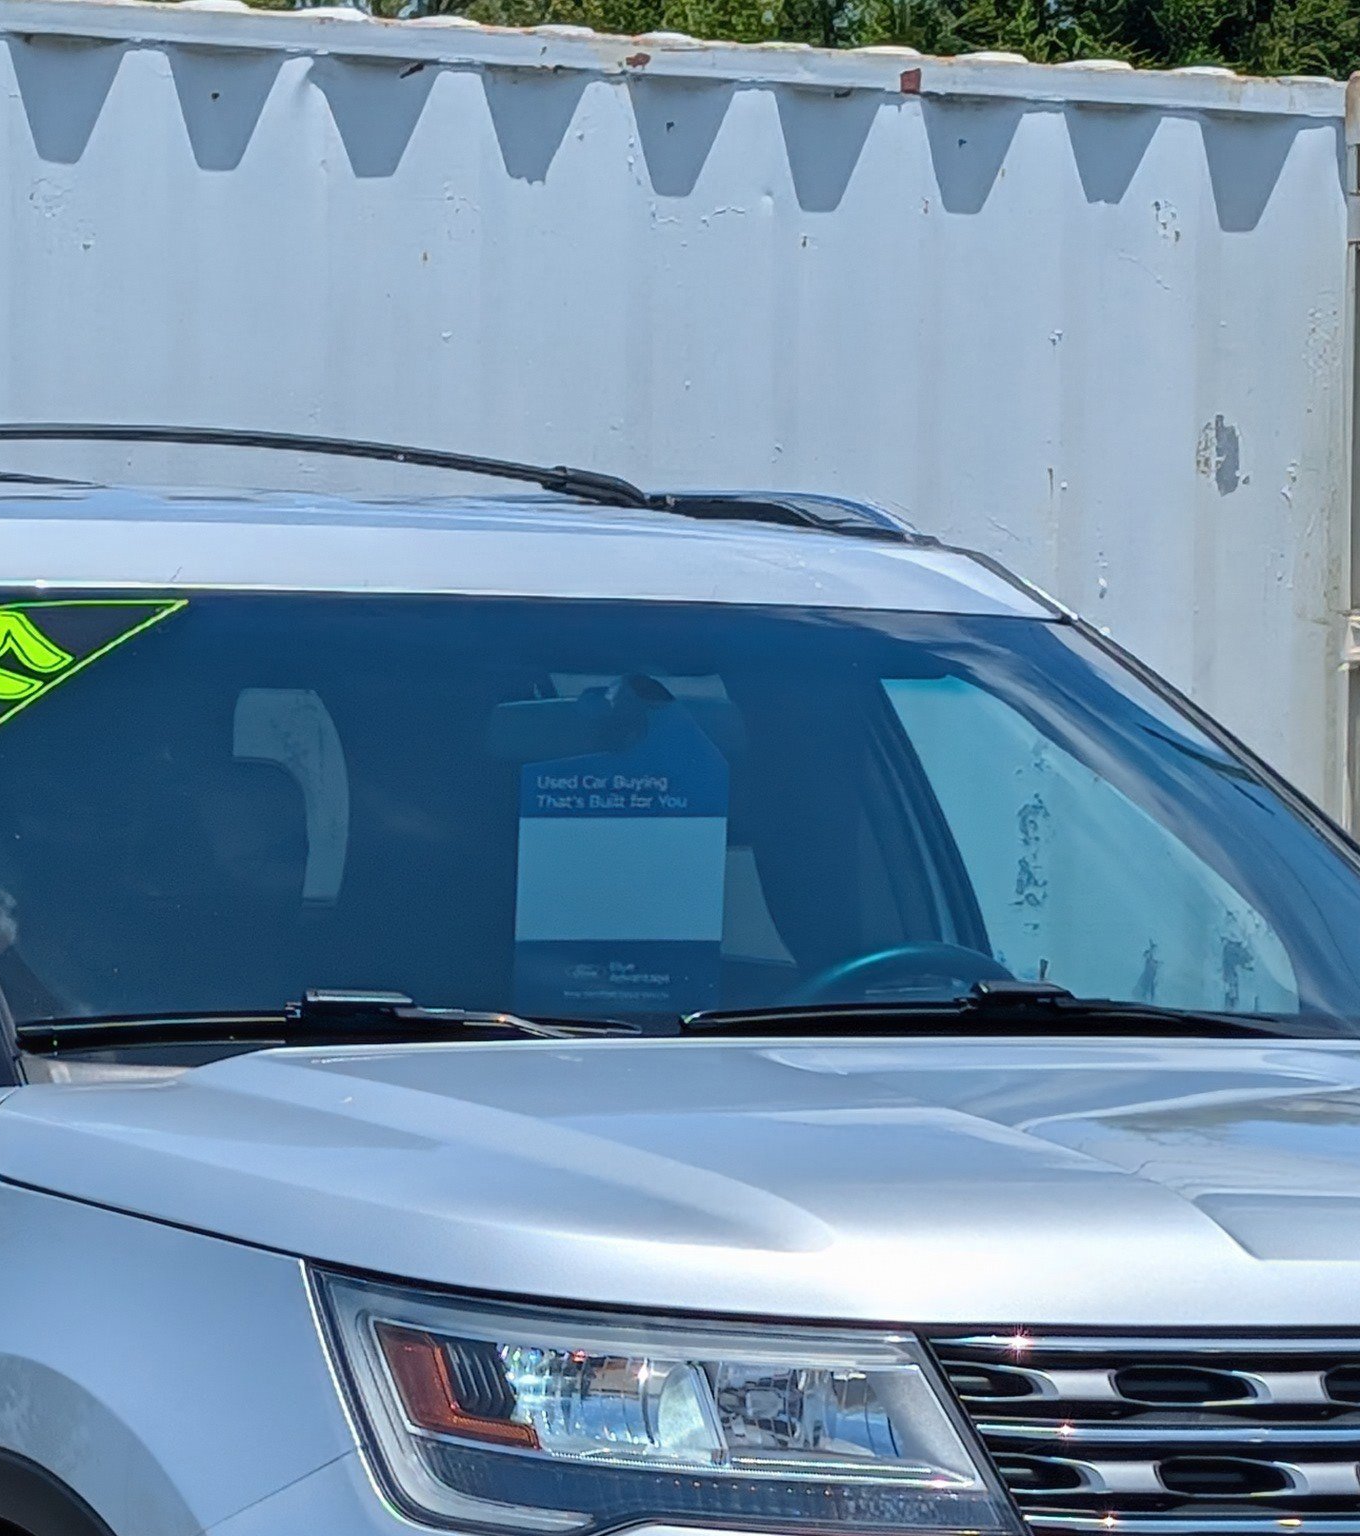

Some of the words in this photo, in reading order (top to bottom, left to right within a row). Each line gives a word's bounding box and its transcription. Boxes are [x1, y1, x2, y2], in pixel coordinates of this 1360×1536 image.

[537, 775, 579, 790] Used
[582, 775, 607, 790] Car
[613, 774, 668, 792] Buying
[537, 794, 585, 809] That's
[589, 793, 625, 809] Built
[658, 794, 688, 809] You
